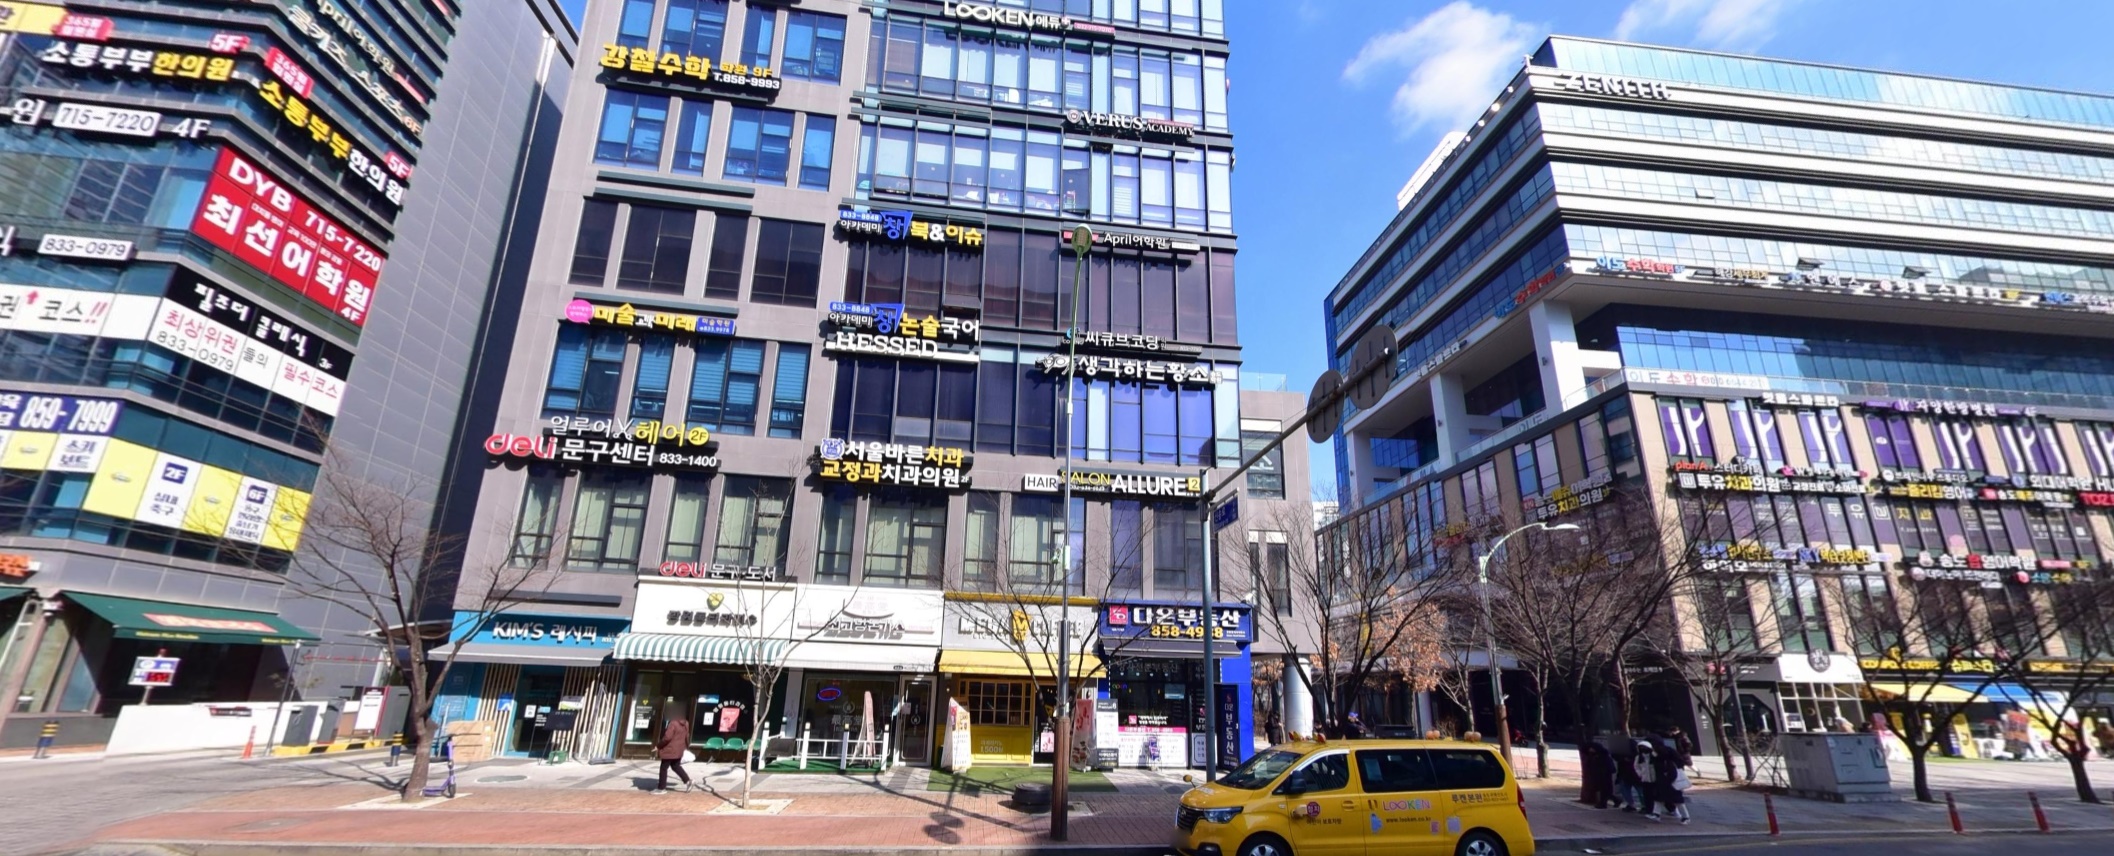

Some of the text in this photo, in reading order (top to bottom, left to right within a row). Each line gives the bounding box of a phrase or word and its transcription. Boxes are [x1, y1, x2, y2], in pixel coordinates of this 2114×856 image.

[211, 33, 243, 51] 5F
[317, 0, 395, 76] pril어학원
[41, 40, 235, 81] 소통부부한의원
[600, 44, 773, 81] 강철수학 학원 9F
[713, 72, 781, 89] T.858-9993
[1565, 74, 1669, 99] ZENITH
[60, 106, 155, 132] 715-7220
[172, 118, 211, 138] 4F
[1083, 111, 1144, 130] VERUS
[1145, 123, 1195, 136] ACADEMY
[257, 79, 404, 207] 소통부부한의원
[386, 154, 410, 179] 5F
[228, 156, 383, 273] DYB 715-7220
[840, 217, 983, 246] 아카데미 창 북&이슈
[1102, 232, 1168, 249] April어학원
[43, 236, 127, 258] 833-0979
[202, 193, 371, 314] 최선어학원
[341, 307, 363, 321] 4F
[594, 301, 698, 333] 미술과미래
[701, 317, 731, 328] 미술학원
[829, 311, 980, 341] 아카데미 창 논술국어
[156, 330, 235, 373] 833-0979
[836, 331, 938, 358] HESSED
[1085, 330, 1160, 351] 씨큐브코딩
[164, 308, 239, 356] 최상위권
[284, 361, 339, 400] 필수코스
[319, 356, 334, 371] 3F
[1078, 355, 1209, 383] 생각하는황소
[19, 396, 118, 432] 859-7999
[550, 415, 708, 447] 얼루어 헤어 2F
[485, 432, 718, 468] deli 문구센터 833-1400
[845, 441, 965, 468] 서울바른치과
[165, 465, 187, 480] 2F
[819, 460, 960, 489] 교정과치과의원
[1697, 473, 1781, 493] 투유치과의원
[2029, 474, 2093, 491] 외대어학원
[1027, 477, 1057, 489] HAIR
[1112, 476, 1187, 497] ALLURE
[1536, 486, 1604, 519] 투유치과의원
[659, 561, 707, 578] deli
[1132, 606, 1242, 628] 다온부동산
[493, 621, 598, 644] KIM'S 레시피
[1151, 625, 1224, 639] 858-498
[1382, 800, 1431, 811] LOOKEN
